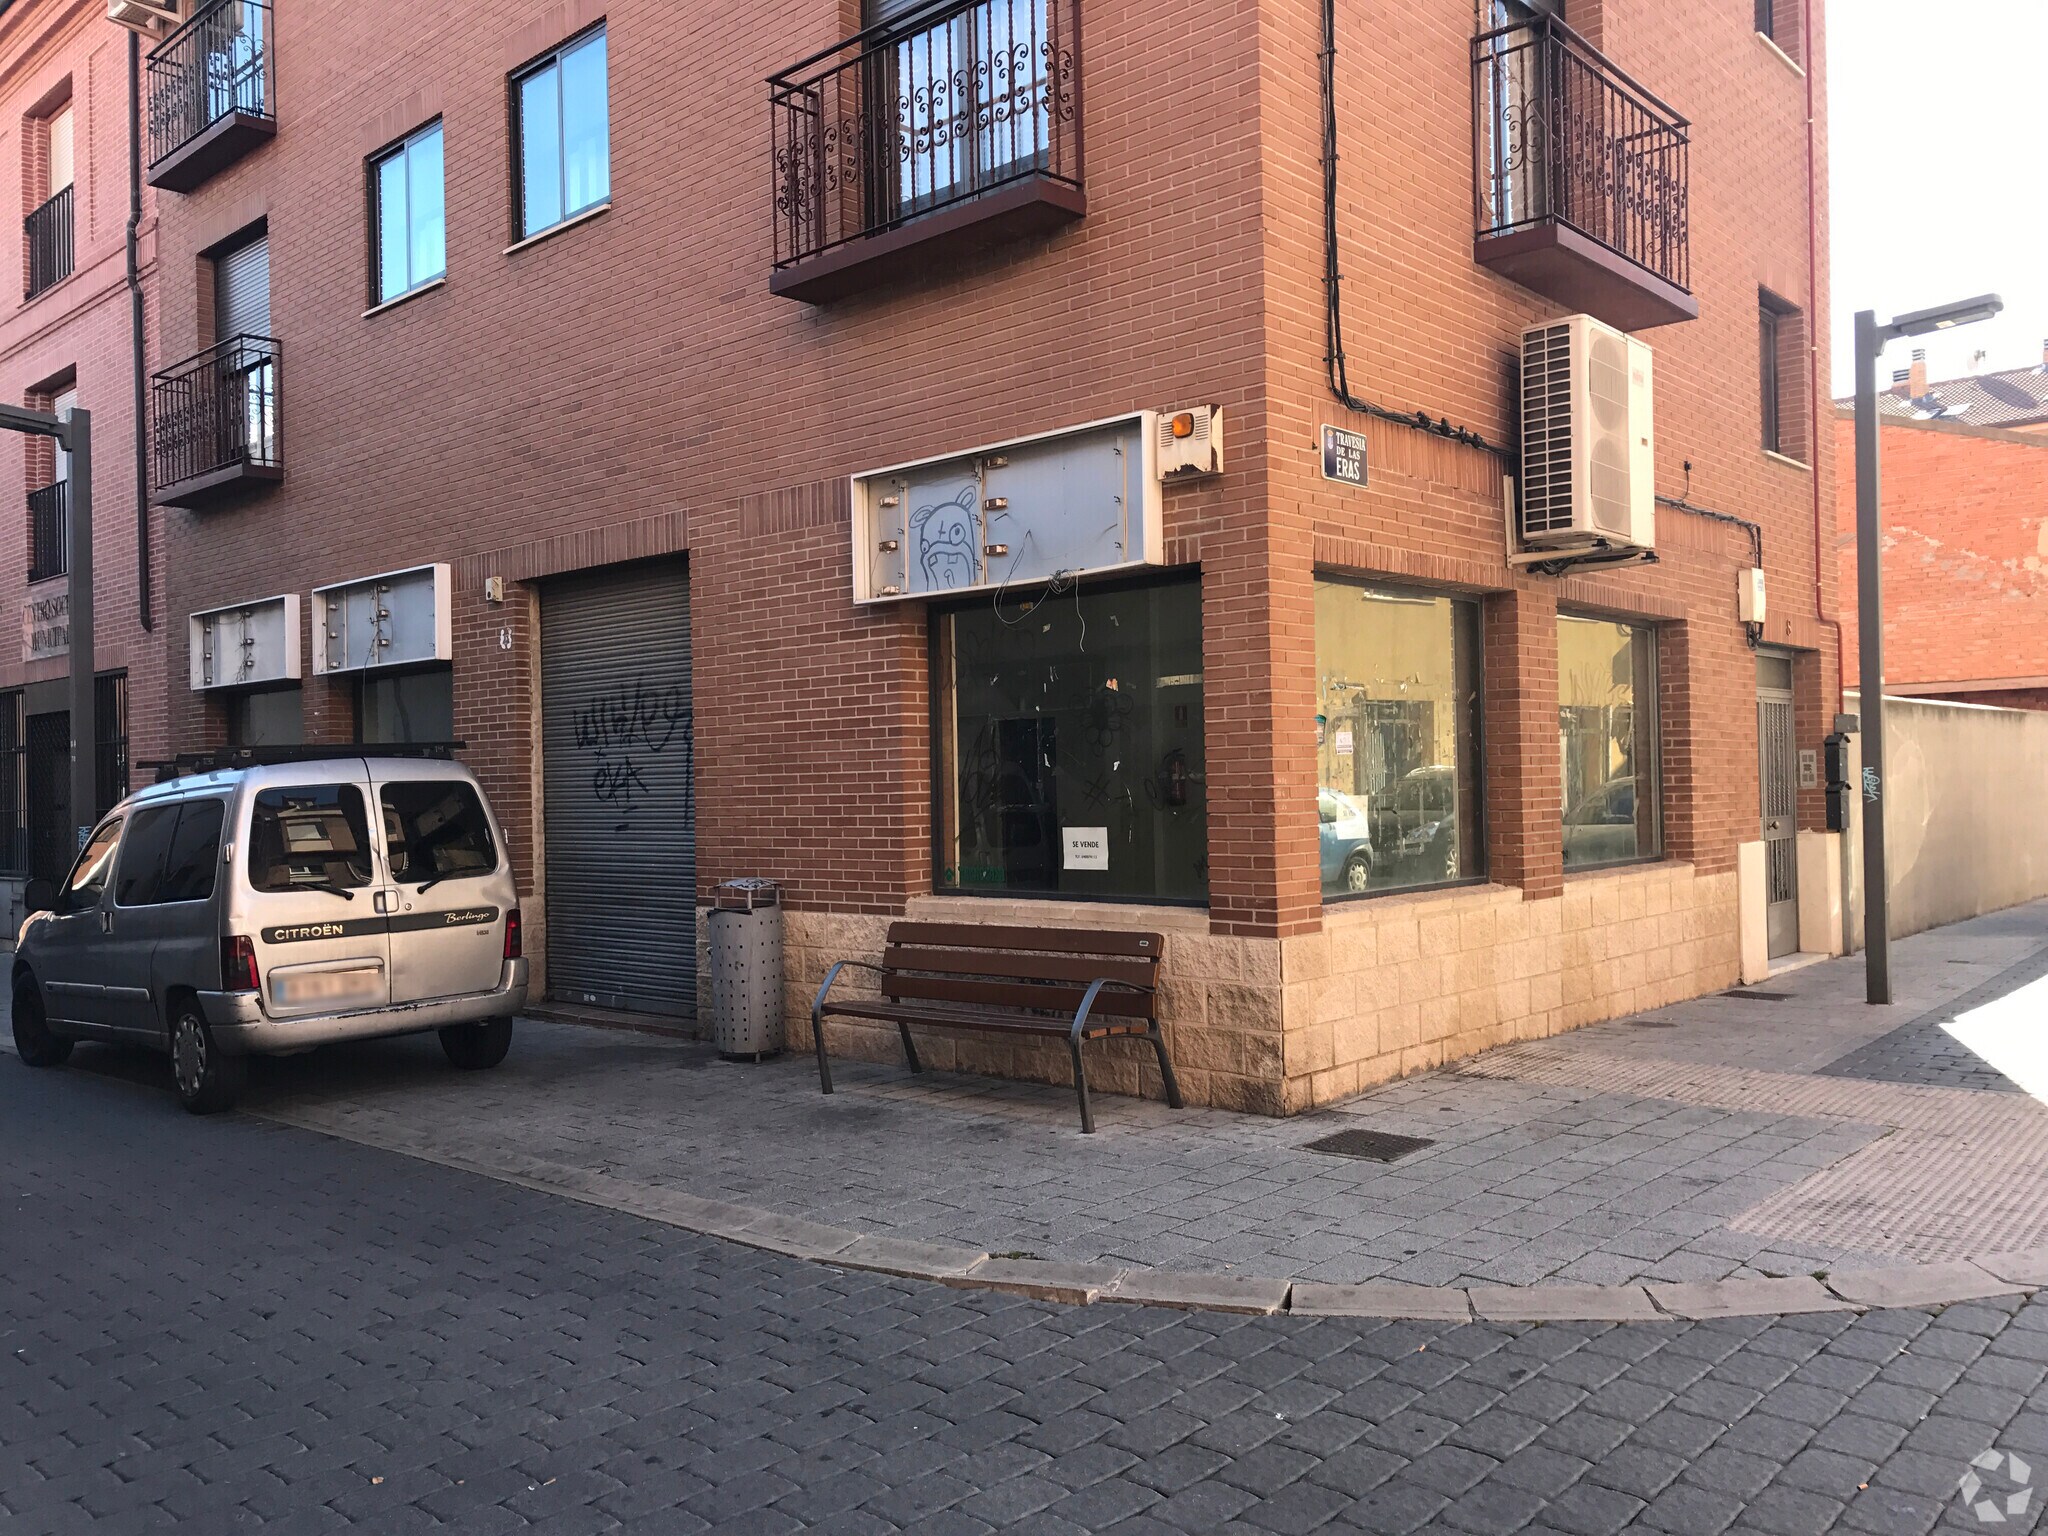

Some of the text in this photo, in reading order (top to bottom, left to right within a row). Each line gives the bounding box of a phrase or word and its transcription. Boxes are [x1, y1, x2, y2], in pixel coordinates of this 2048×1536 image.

[1336, 446, 1361, 461] DE LAS
[1336, 458, 1360, 481] ERAS
[1072, 840, 1099, 848] SE VENDE
[444, 911, 490, 924] Berlingo
[274, 923, 343, 941] CITROËN
